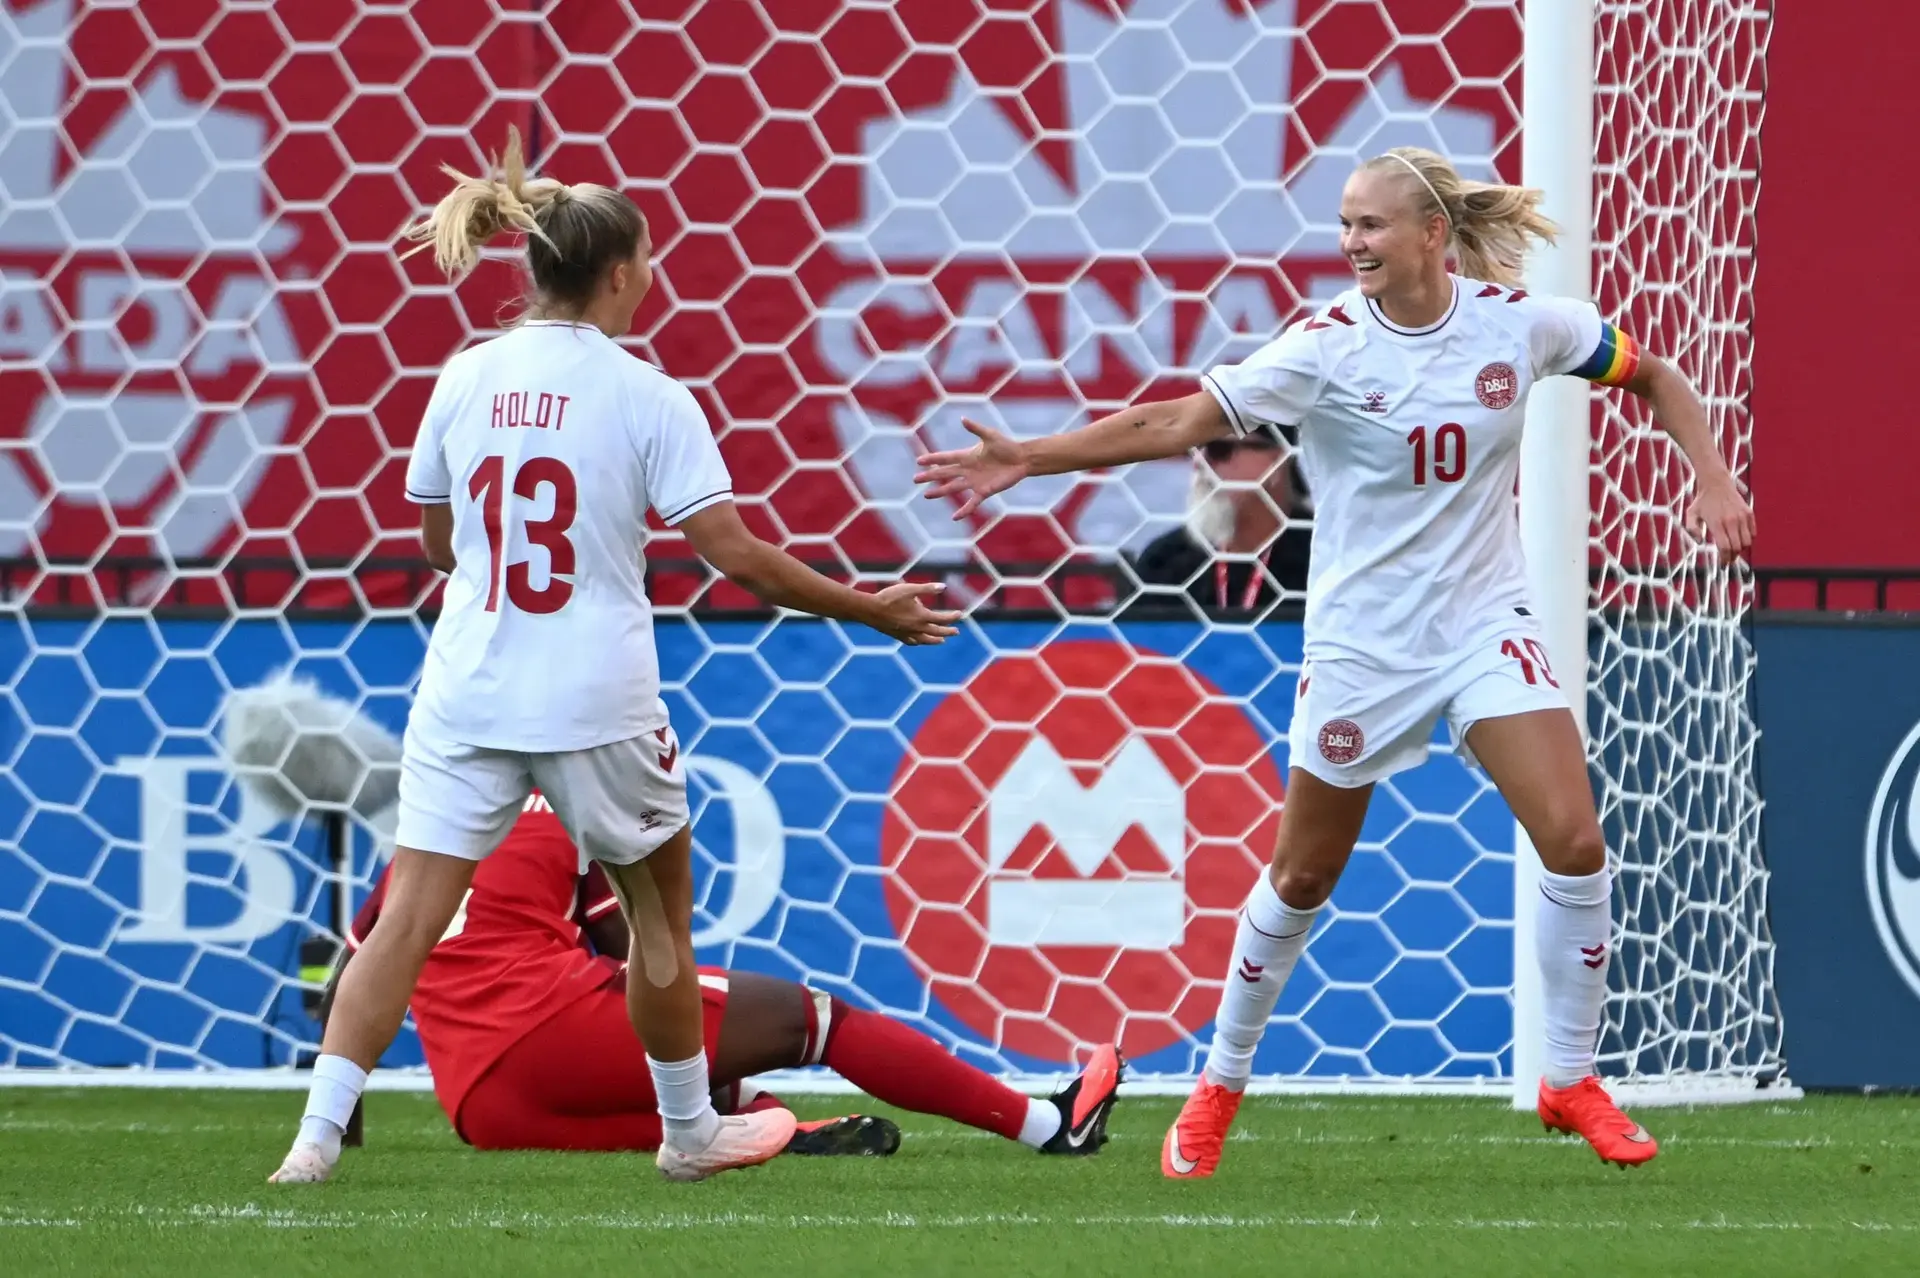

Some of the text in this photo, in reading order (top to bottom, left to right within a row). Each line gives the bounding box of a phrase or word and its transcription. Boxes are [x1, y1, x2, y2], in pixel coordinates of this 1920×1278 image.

[1484, 378, 1510, 394] DBU
[492, 391, 571, 431] HOLDT
[1407, 422, 1468, 485] 10
[468, 455, 577, 614] 13
[1500, 638, 1560, 689] 10
[1327, 734, 1354, 748] DBU
